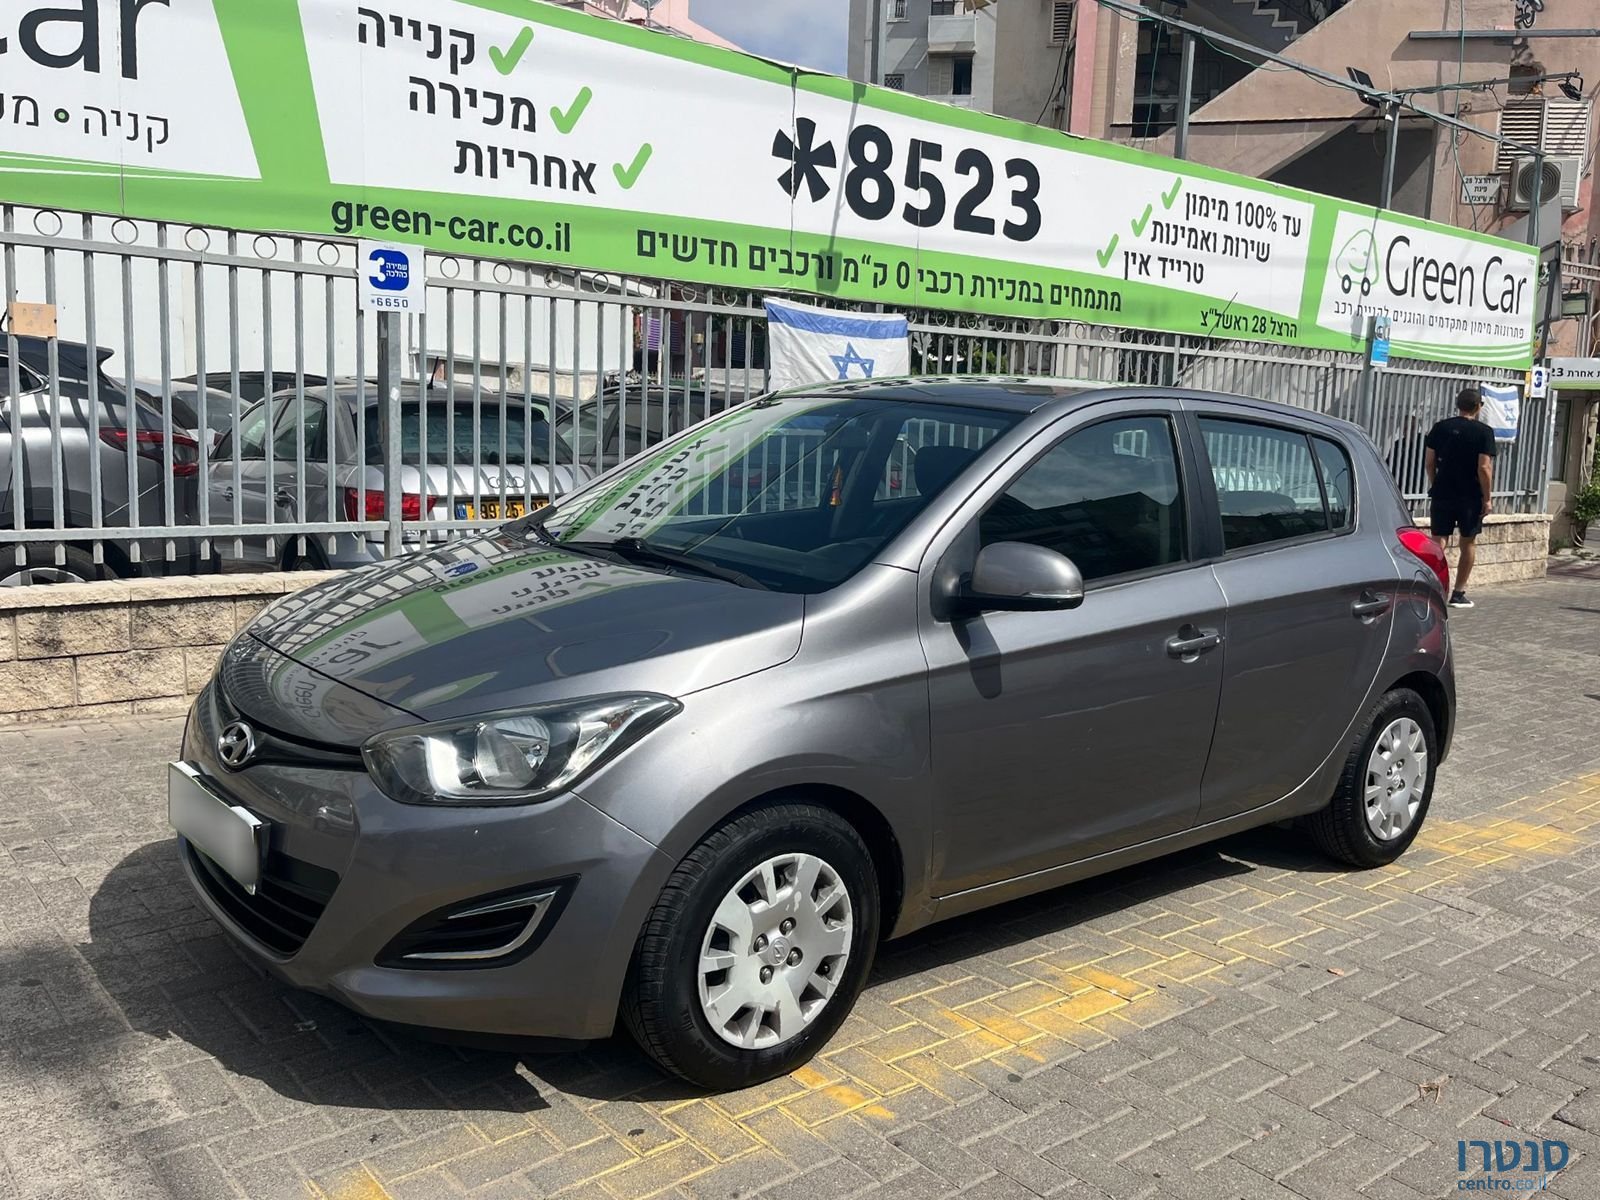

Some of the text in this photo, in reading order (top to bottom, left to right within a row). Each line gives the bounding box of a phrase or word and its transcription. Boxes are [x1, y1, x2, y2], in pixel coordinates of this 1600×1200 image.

[0, 0, 171, 80] ar
[357, 6, 475, 75] קנייה
[408, 75, 537, 133] מכירה
[83, 105, 170, 153] קניה
[453, 139, 597, 195] אחריות
[331, 200, 571, 252] green-car.co.il
[1185, 192, 1302, 238] עד 100% מימון
[637, 229, 738, 268] חדשים
[1150, 220, 1271, 262] שירות ואמינות
[385, 262, 408, 271] שמירה
[749, 244, 834, 280] ורכבים
[896, 260, 910, 290] 0
[1123, 250, 1204, 284] טרייד אין
[1385, 235, 1527, 315] Green Car
[917, 268, 964, 296] רכבי
[970, 274, 1044, 303] במכירת
[1050, 283, 1122, 313] מתמחים
[1252, 315, 1267, 334] 28
[1333, 300, 1353, 316] רכב
[1270, 316, 1297, 338] הרצל
[1471, 320, 1492, 336] מימון
[1494, 324, 1524, 339] פתרונות
[1567, 370, 1594, 378] אחרת
